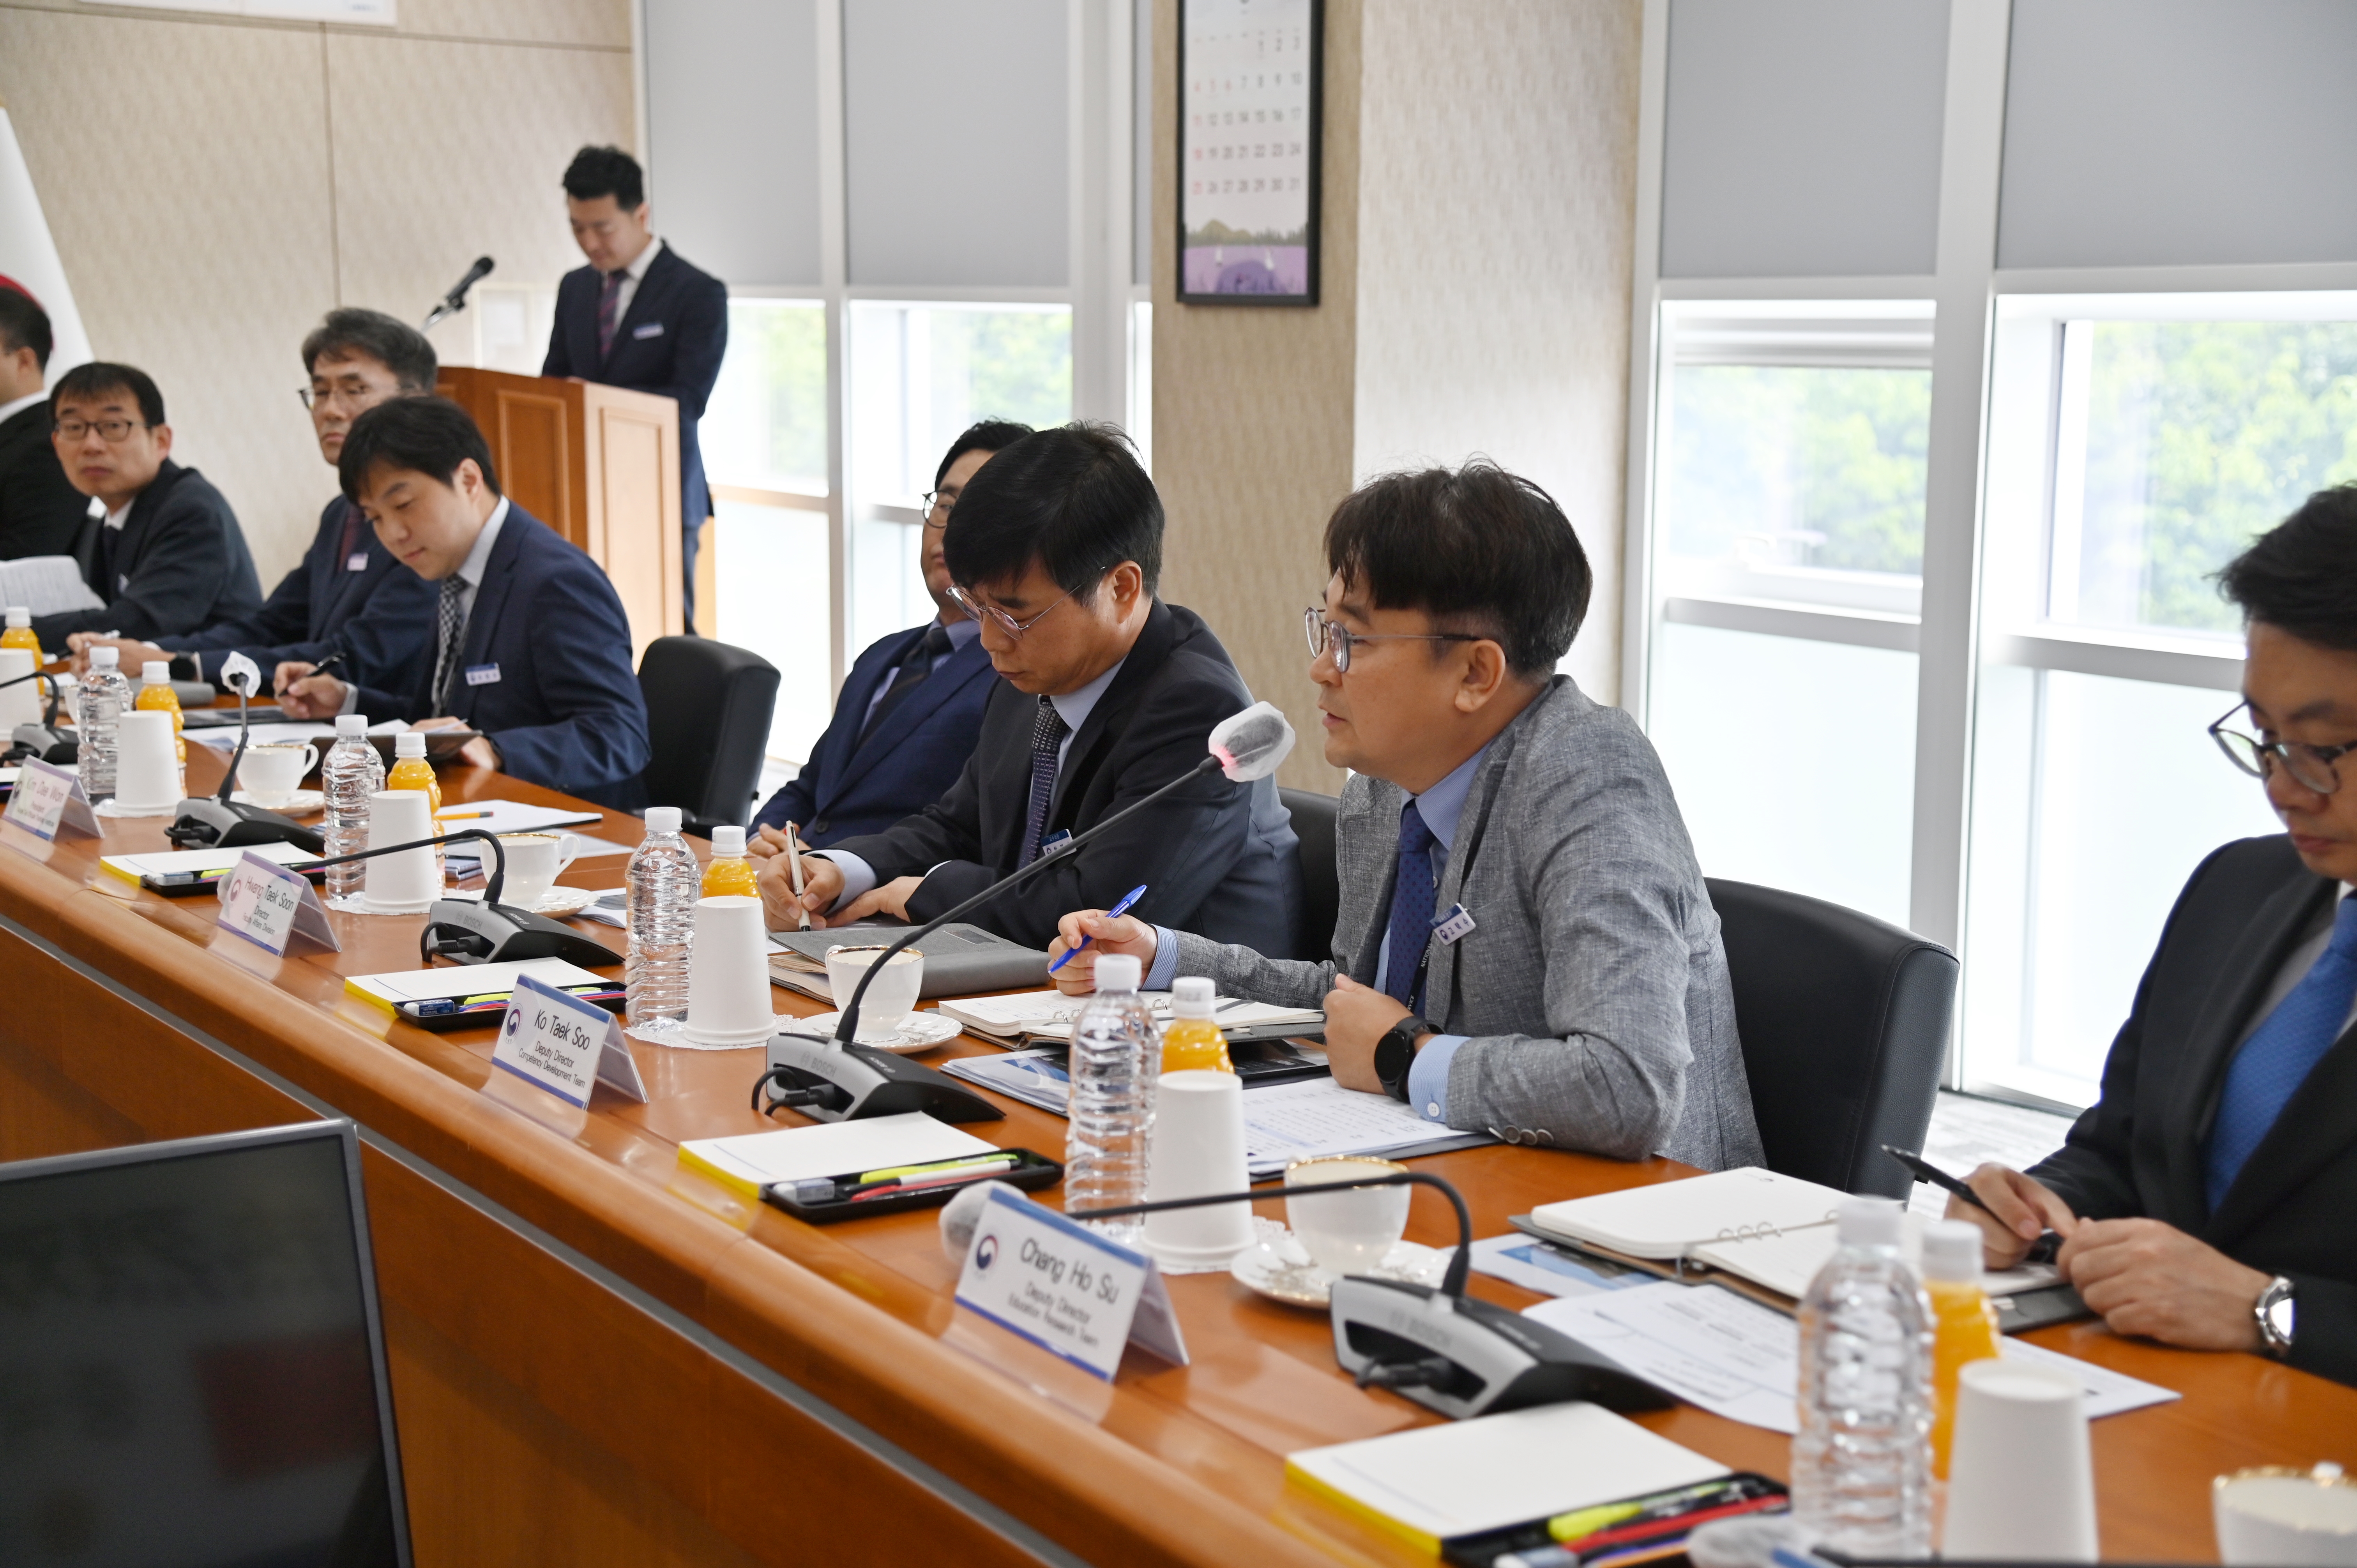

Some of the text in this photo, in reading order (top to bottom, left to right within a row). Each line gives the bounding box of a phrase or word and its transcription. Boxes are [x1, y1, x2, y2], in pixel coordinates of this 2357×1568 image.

[245, 876, 294, 912] Hwang Taek Soon
[254, 905, 270, 920] Director
[463, 915, 483, 930] BOSCH
[262, 922, 275, 935] Division
[534, 1009, 590, 1050] Ko Taek Soo
[518, 1047, 585, 1088] Competency Development Team
[535, 1041, 574, 1068] Deputy Director
[811, 1057, 837, 1077] BOSCH
[1020, 1238, 1120, 1305] Chang Ho Su
[1025, 1282, 1091, 1325] Deputy Director
